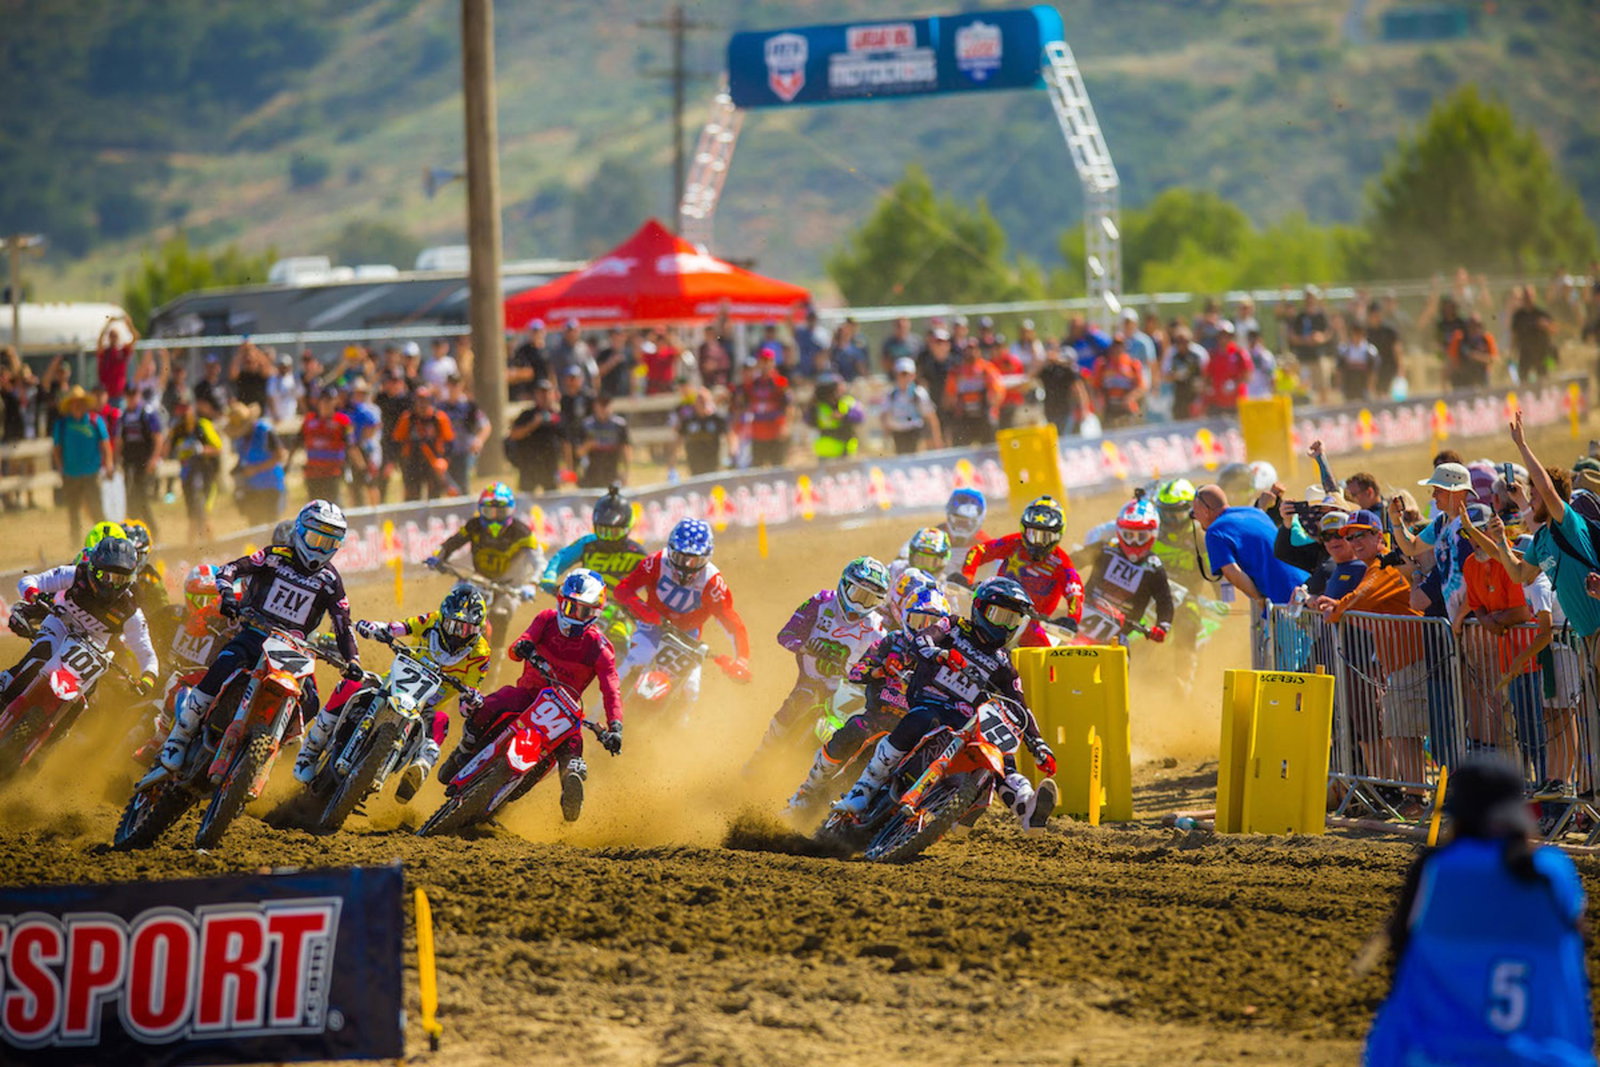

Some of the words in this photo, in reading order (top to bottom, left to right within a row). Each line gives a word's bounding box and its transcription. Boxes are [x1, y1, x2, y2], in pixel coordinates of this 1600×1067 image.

[1112, 560, 1139, 584] FLY
[272, 584, 310, 612] FLY
[60, 645, 102, 681] 101
[655, 645, 697, 677] 69
[395, 667, 433, 701] 21
[530, 701, 573, 740] 94
[980, 711, 1018, 752] 19
[0, 903, 334, 1043] SPORT
[1489, 961, 1526, 1032] 5
